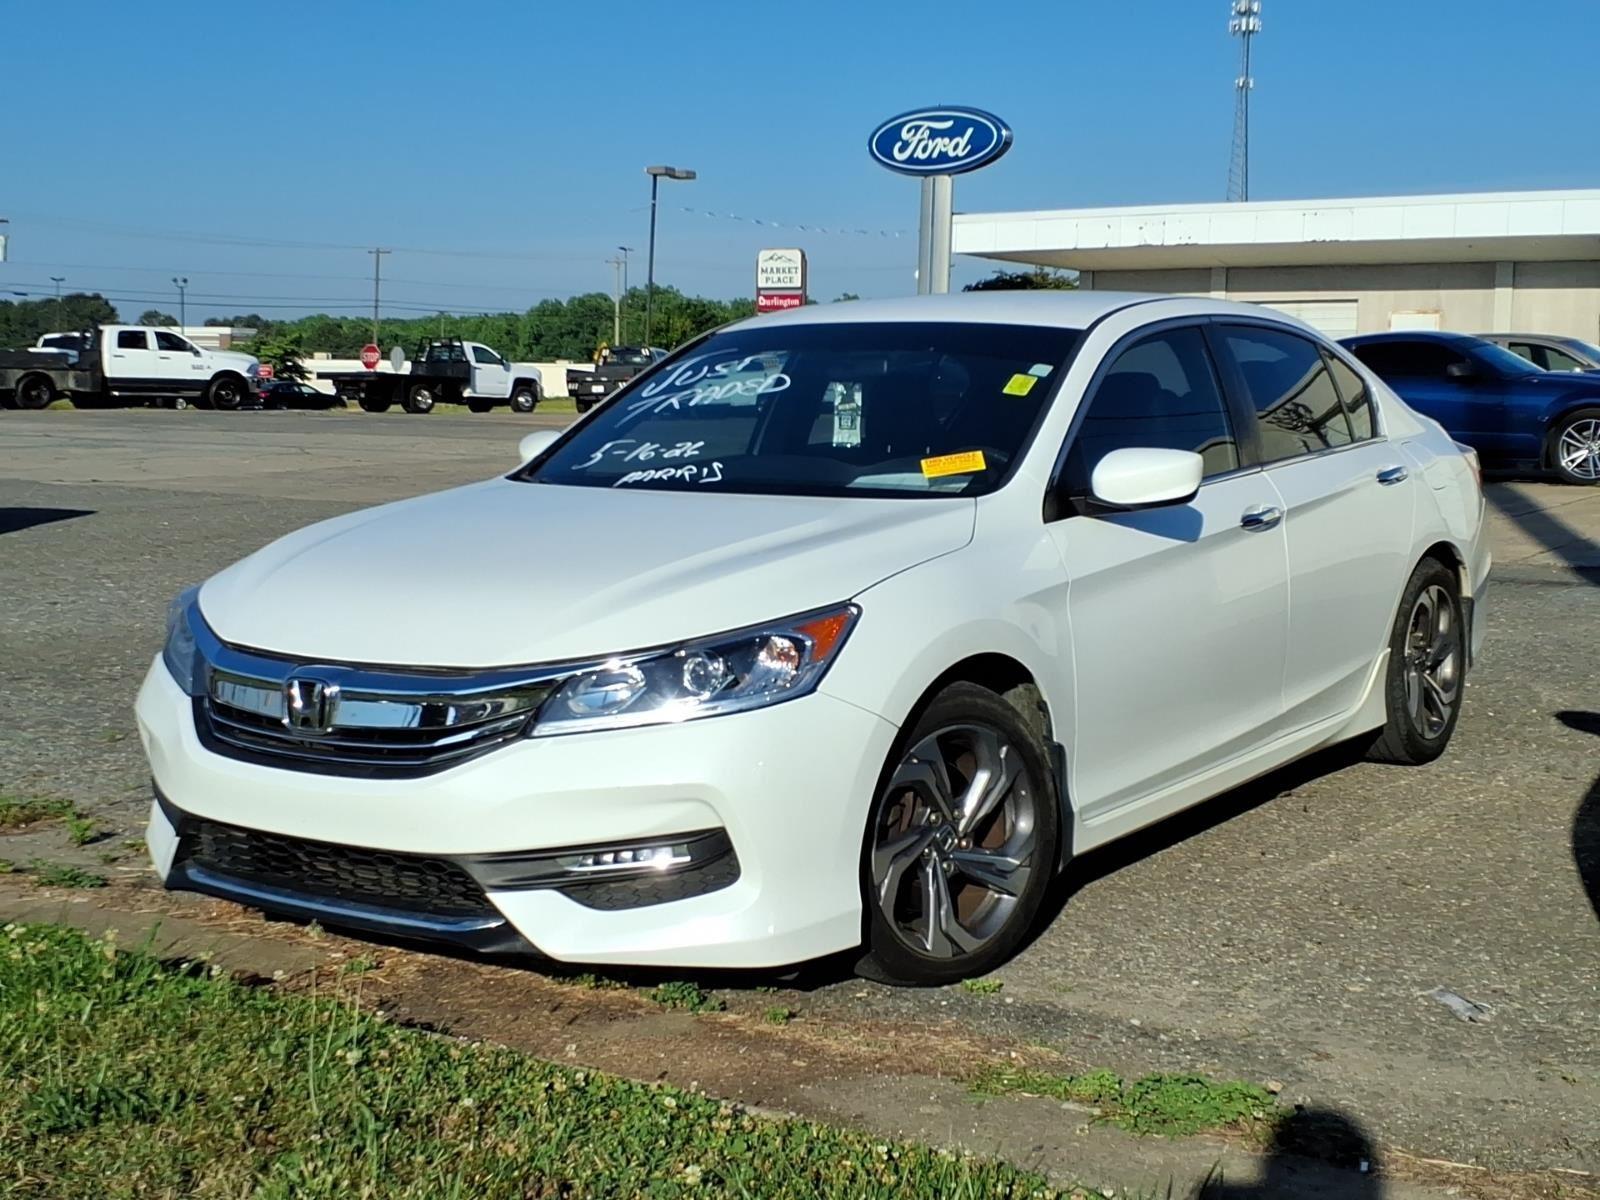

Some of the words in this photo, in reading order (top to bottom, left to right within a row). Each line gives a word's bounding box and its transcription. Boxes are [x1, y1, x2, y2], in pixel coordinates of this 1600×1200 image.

[893, 119, 974, 161] Ford
[760, 266, 798, 275] MARKET
[765, 276, 794, 284] PLACE
[362, 351, 379, 362] STOP
[641, 348, 788, 398] JUST
[614, 373, 791, 428] TRADED
